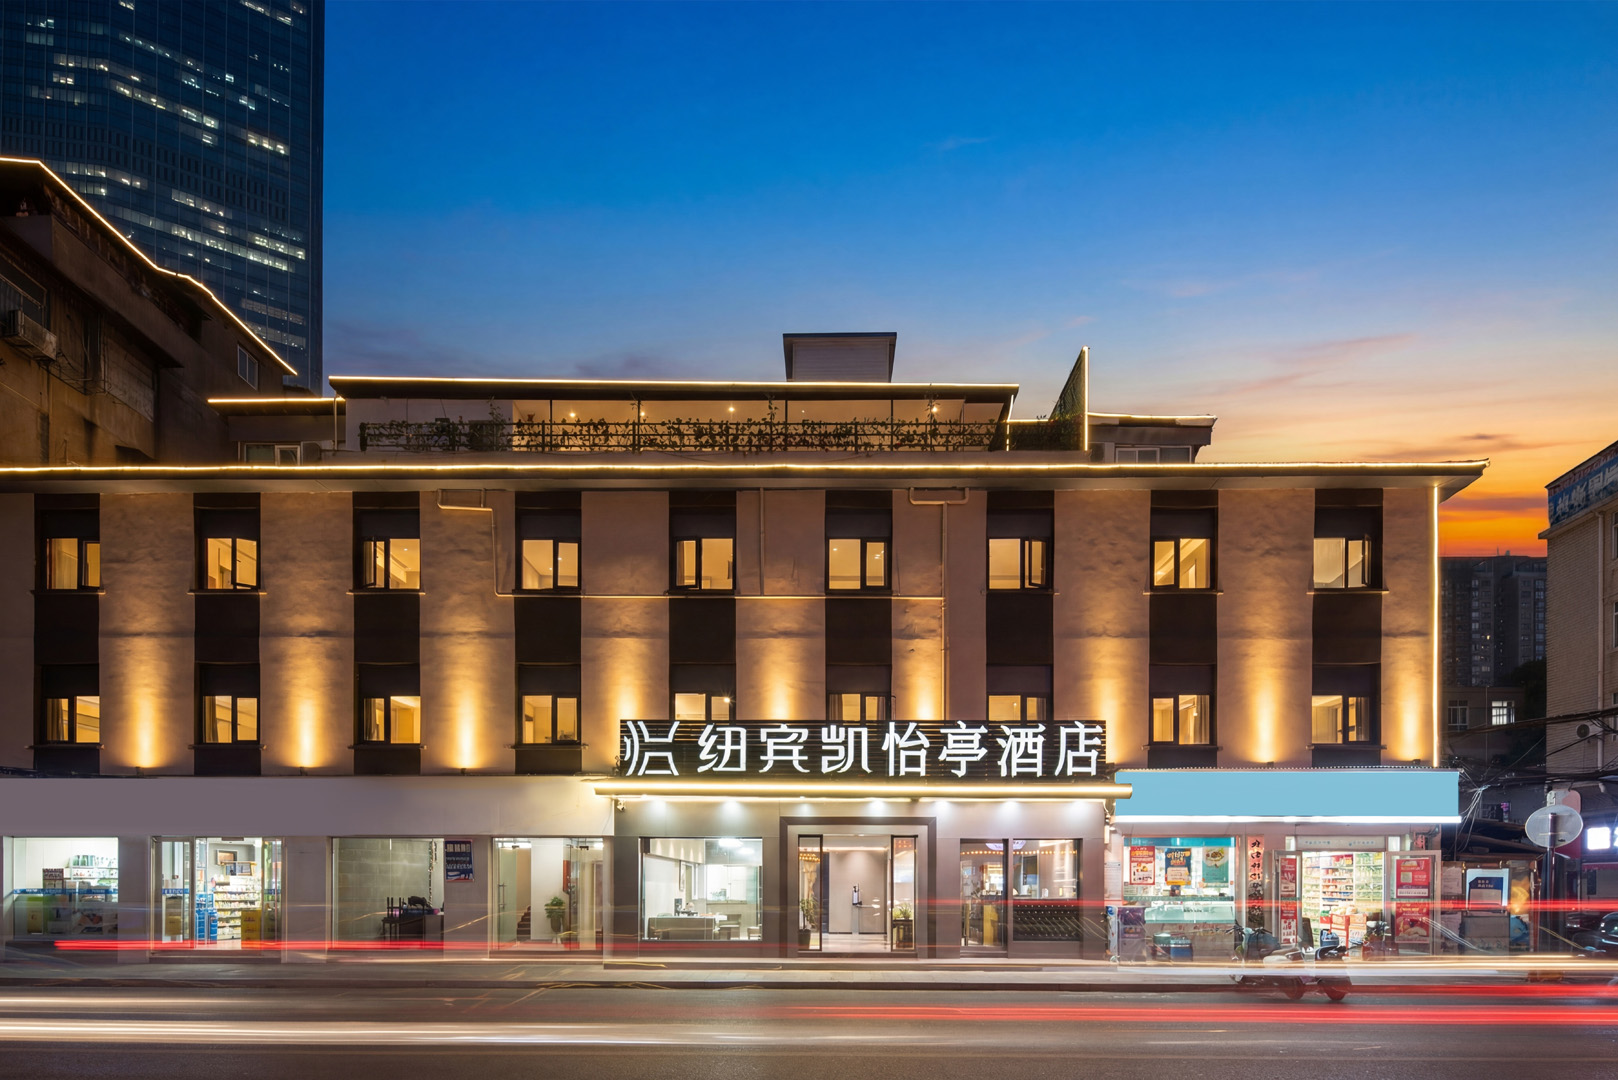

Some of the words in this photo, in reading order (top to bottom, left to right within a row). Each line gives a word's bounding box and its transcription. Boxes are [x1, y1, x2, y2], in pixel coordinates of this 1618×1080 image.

[697, 720, 1104, 778] 纽宾凯怡亭酒店
